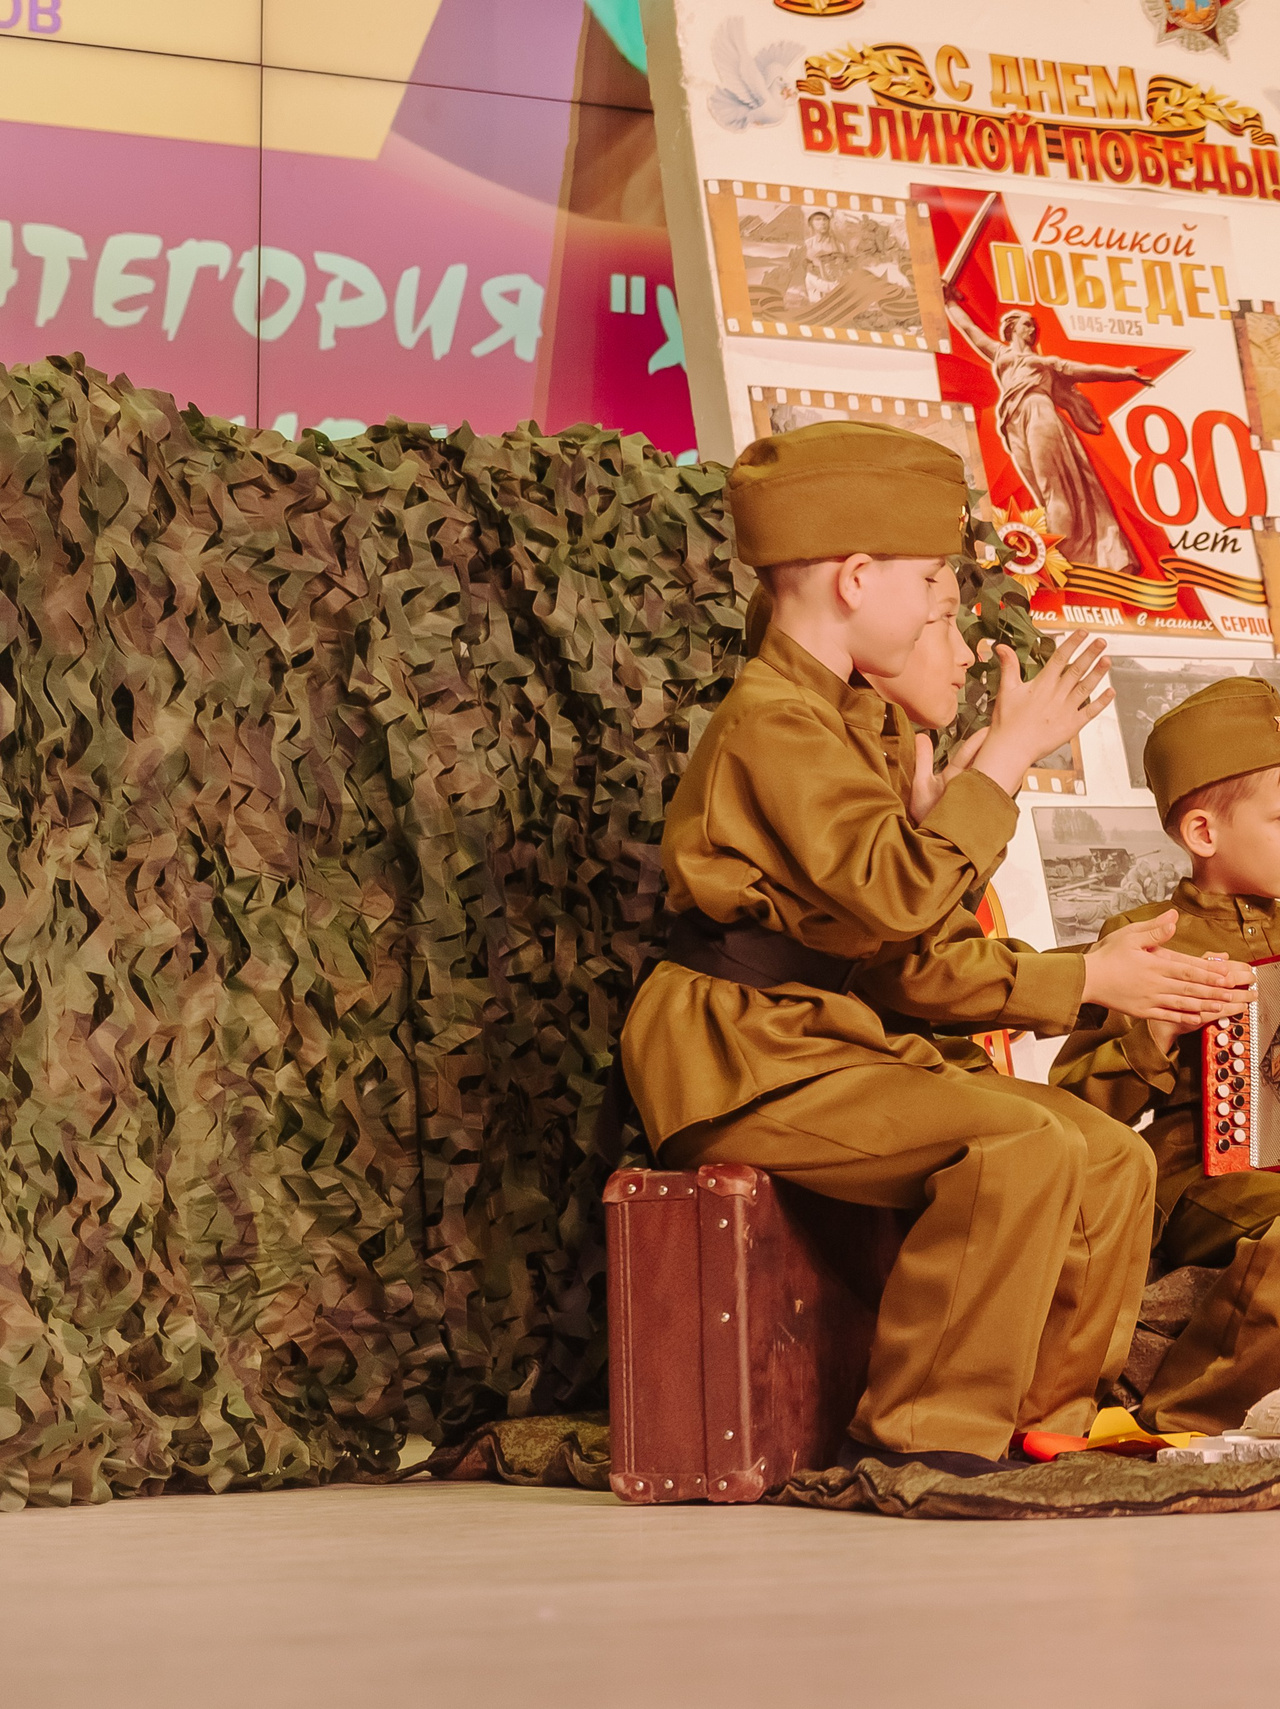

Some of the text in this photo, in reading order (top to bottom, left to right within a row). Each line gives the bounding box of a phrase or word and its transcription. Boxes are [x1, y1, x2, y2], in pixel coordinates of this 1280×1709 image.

[935, 44, 1144, 122] С ДНЕМ
[799, 98, 1051, 178] ВЕЛИКОЙ
[1031, 205, 1198, 257] Великой
[992, 243, 1232, 326] ПОБЕДЕ!
[1070, 314, 1144, 336] 1945-2025
[1126, 405, 1267, 530] 80
[1169, 526, 1242, 553] лет
[1062, 605, 1124, 626] ПОБЕДА
[1136, 612, 1148, 626] в
[1155, 617, 1214, 631] наших
[1220, 615, 1272, 637] СЕРДЦ
